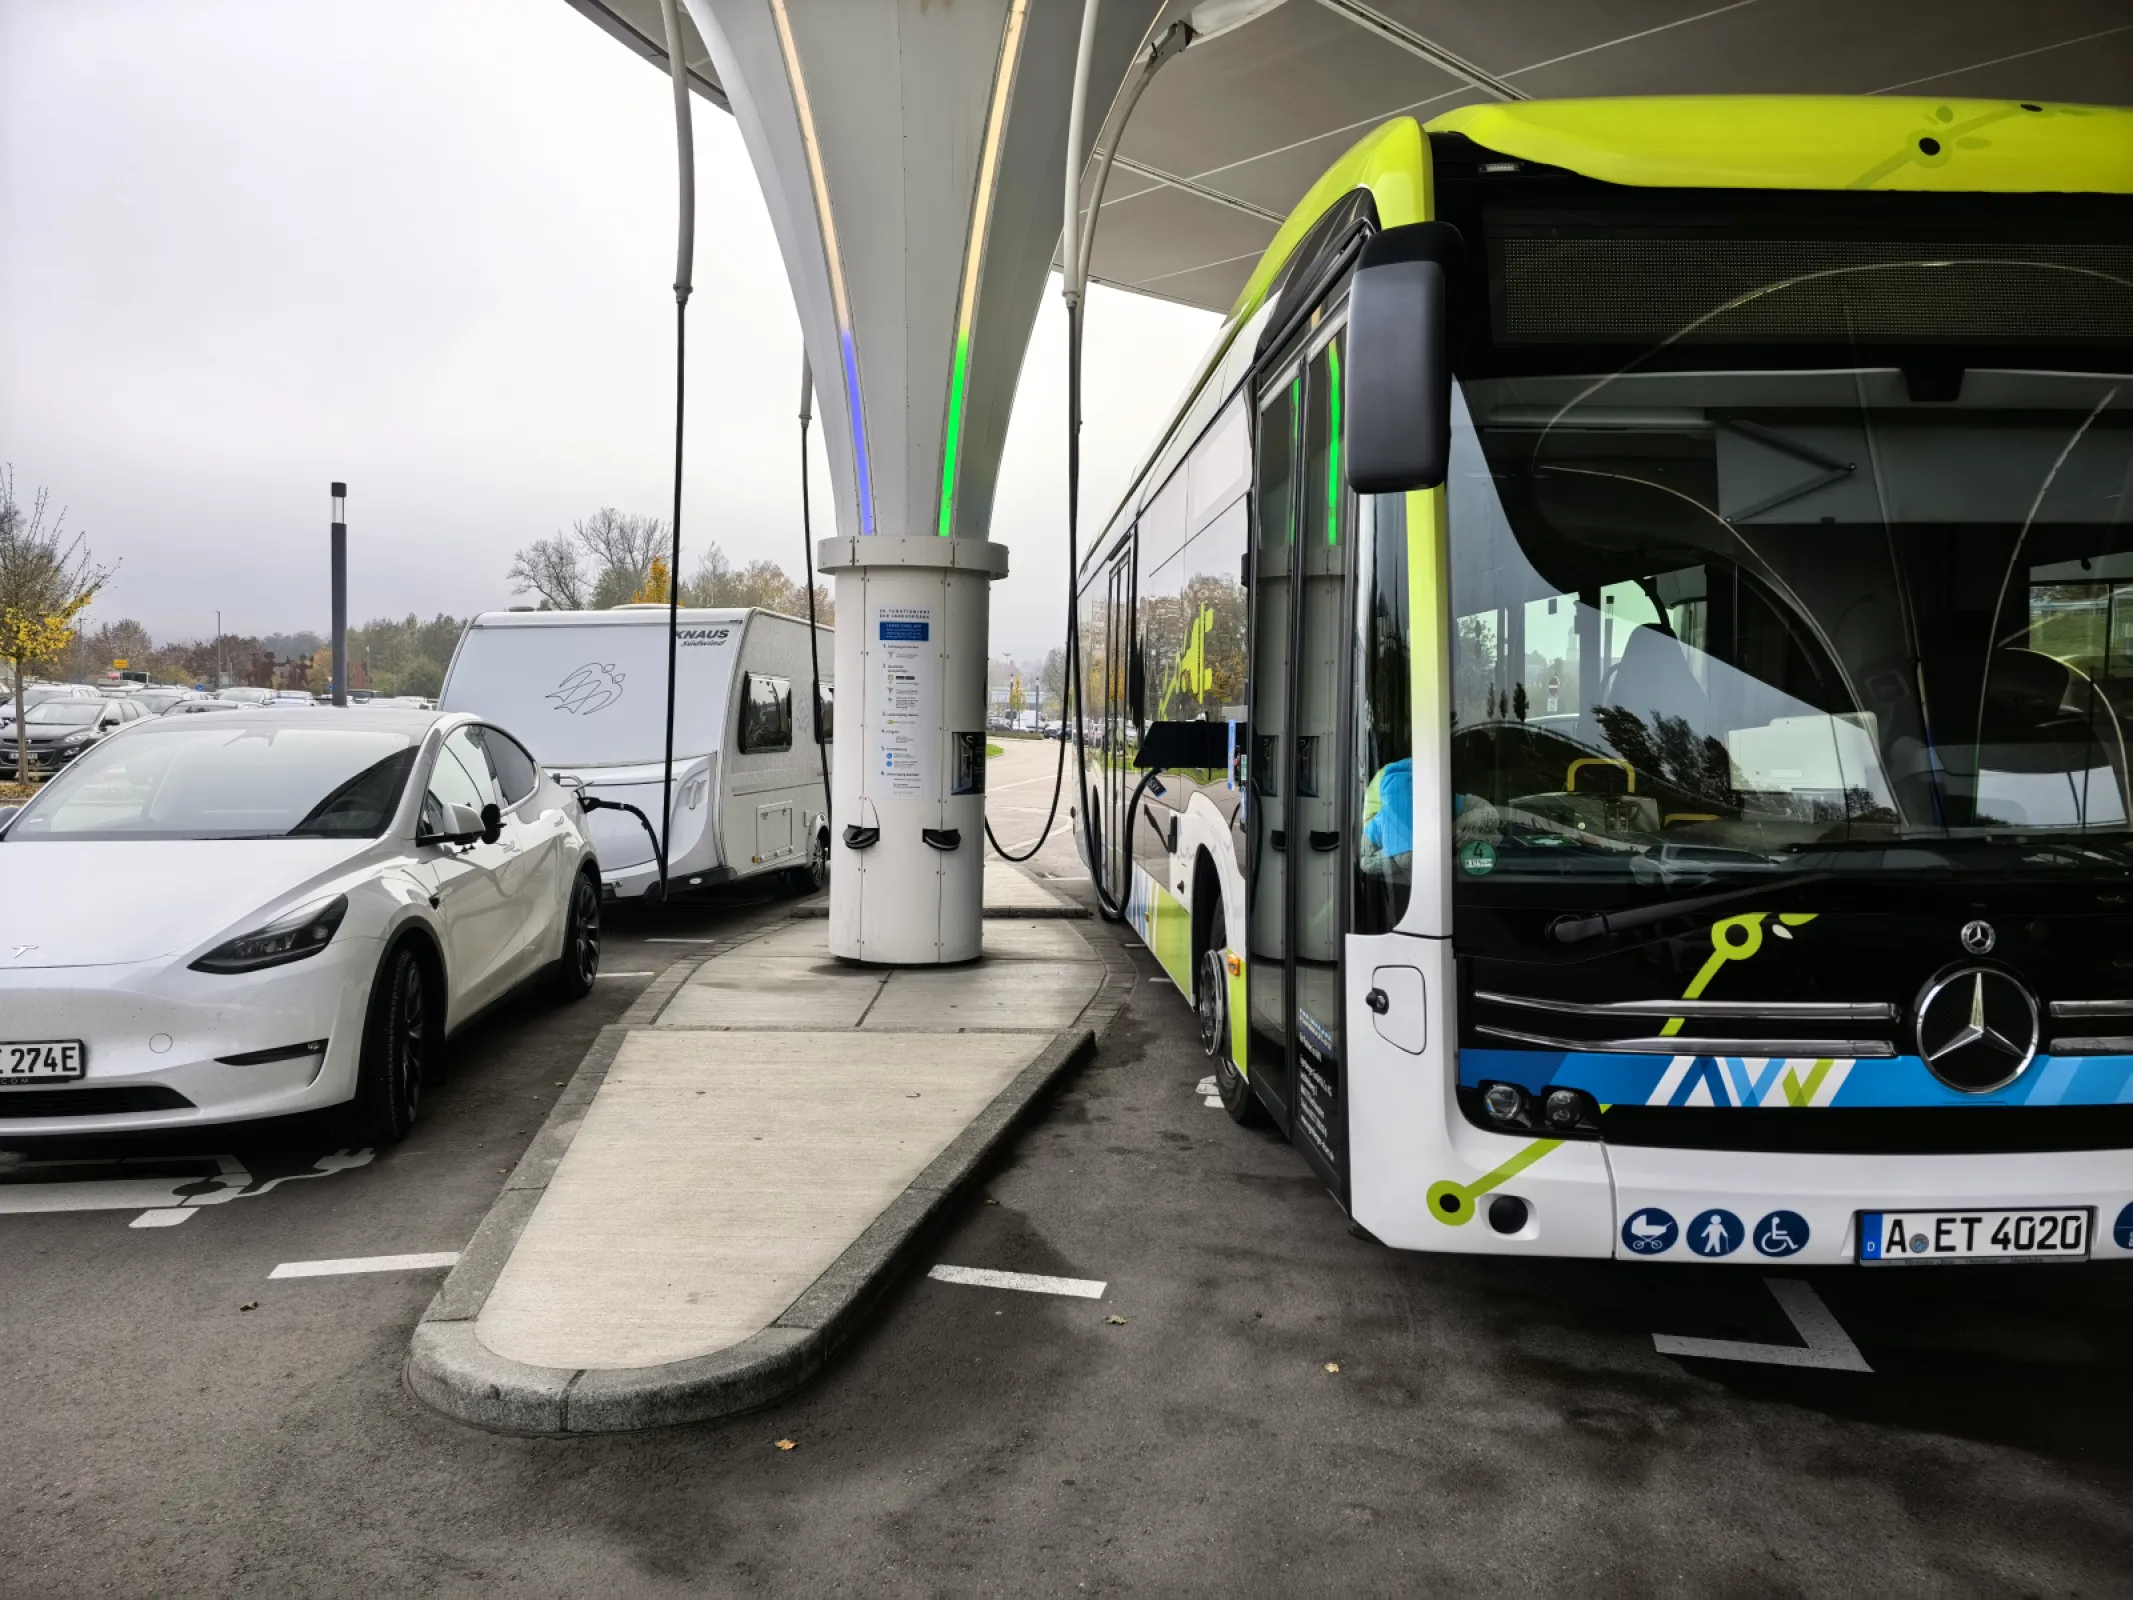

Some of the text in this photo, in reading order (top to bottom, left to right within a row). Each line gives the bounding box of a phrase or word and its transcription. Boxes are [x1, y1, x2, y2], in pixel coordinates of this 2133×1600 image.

[676, 629, 729, 640] KNAUS
[1473, 842, 1484, 858] 4
[11, 1046, 77, 1074] 274E
[1867, 1215, 2082, 1254] D A ET 4020
